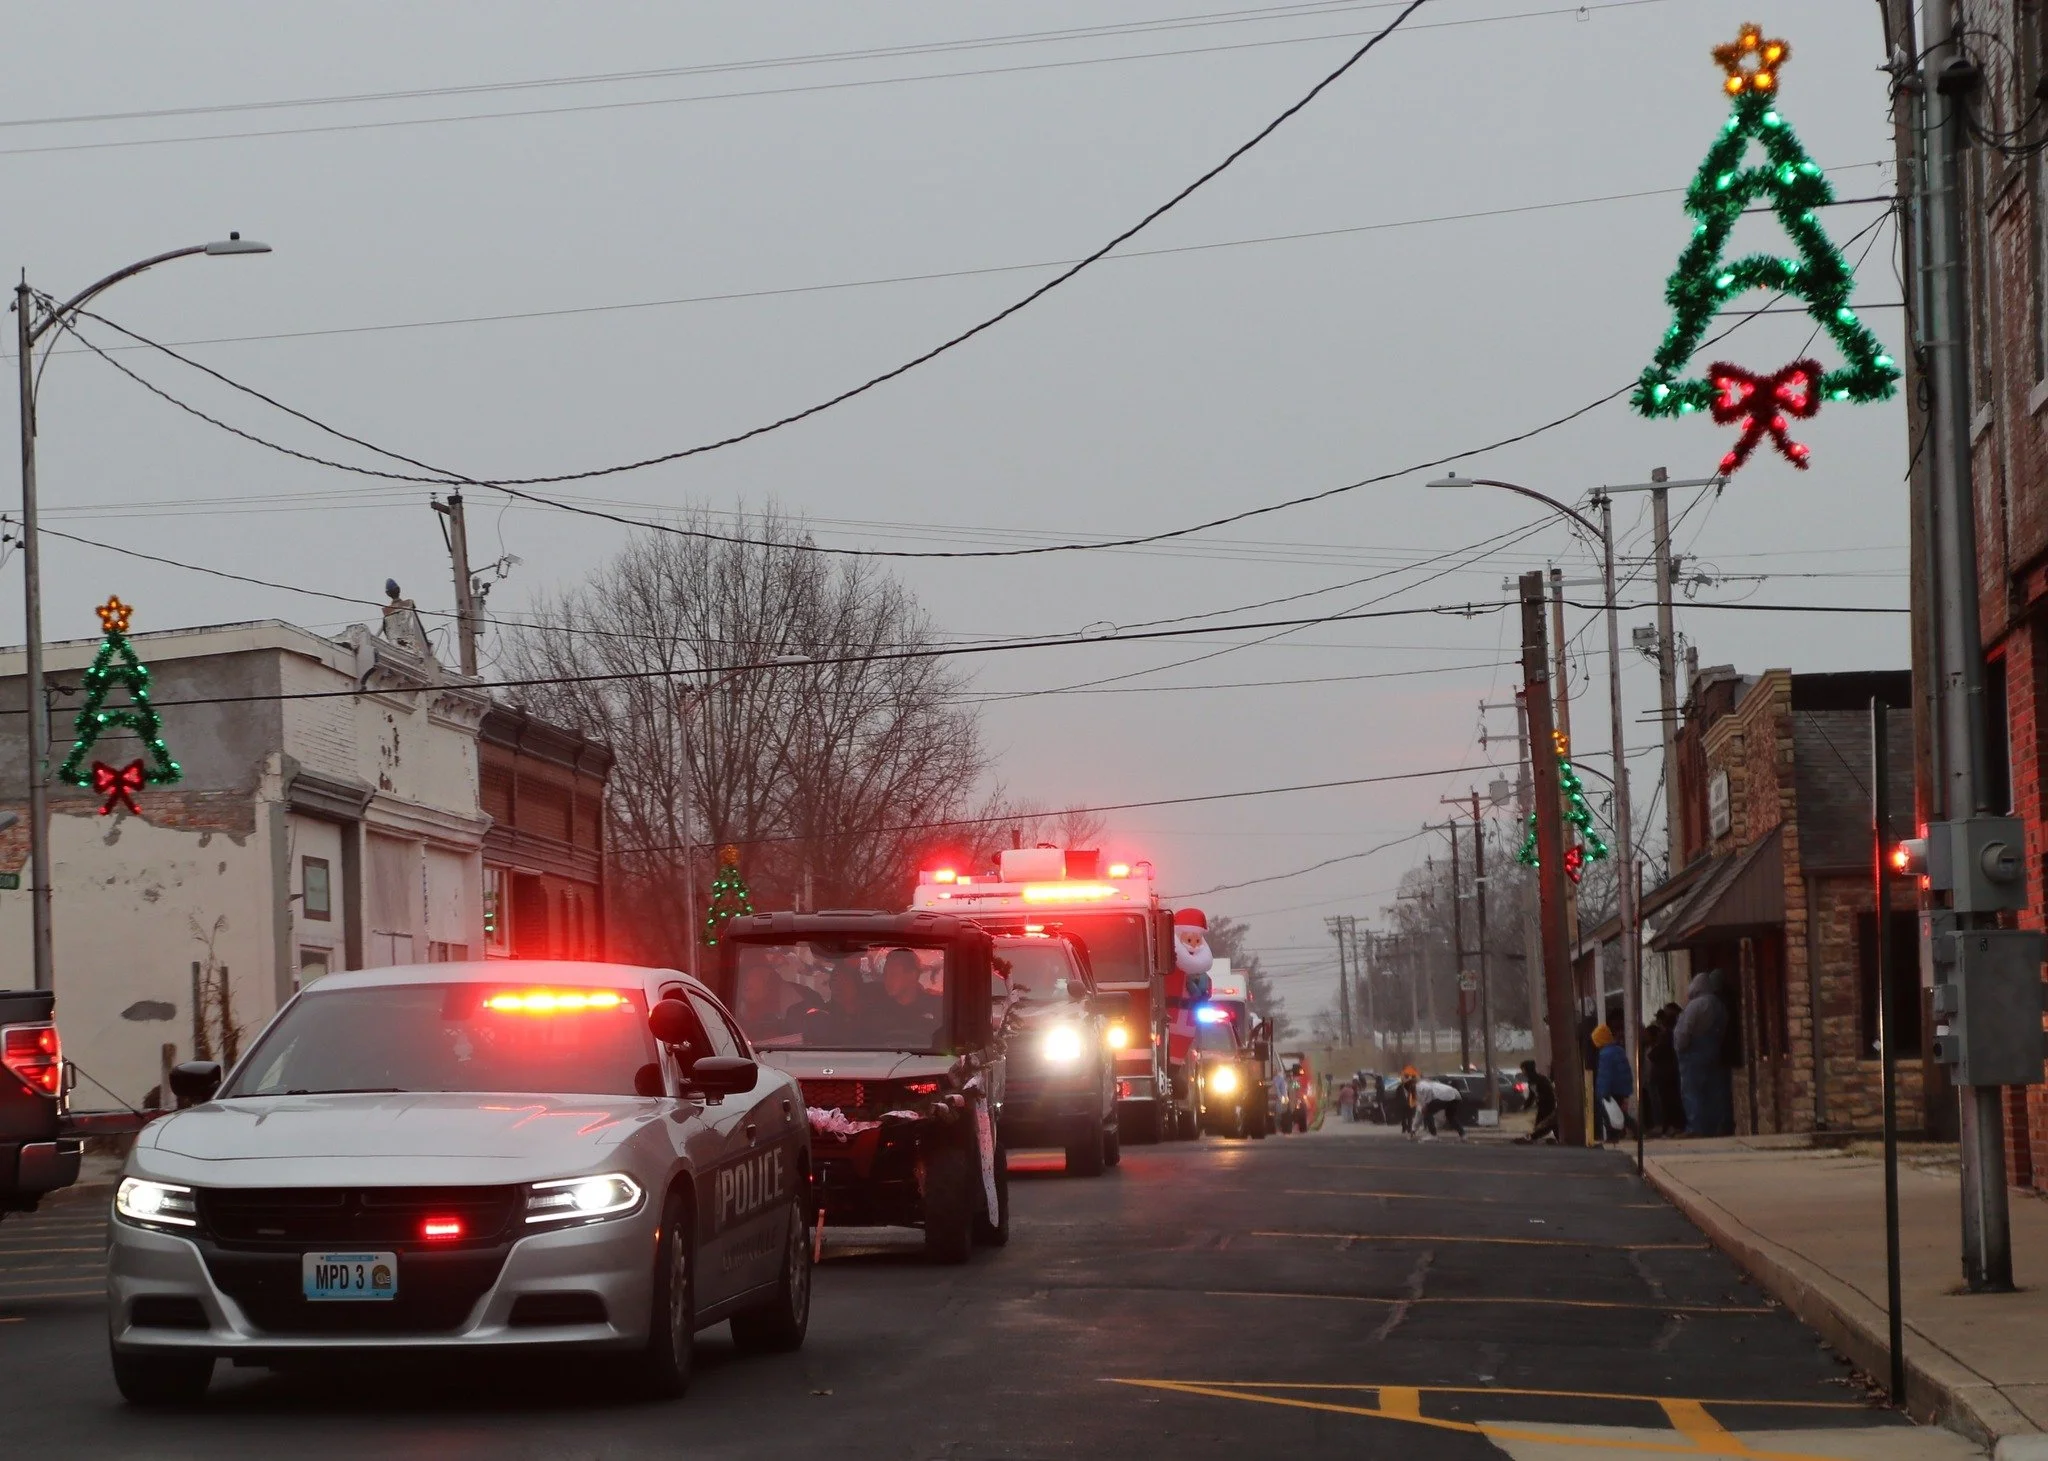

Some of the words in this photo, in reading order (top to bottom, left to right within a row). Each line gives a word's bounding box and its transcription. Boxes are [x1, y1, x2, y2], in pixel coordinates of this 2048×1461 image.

[721, 1147, 783, 1223] POLICE
[316, 1265, 349, 1289] MPD
[356, 1265, 364, 1289] 3
